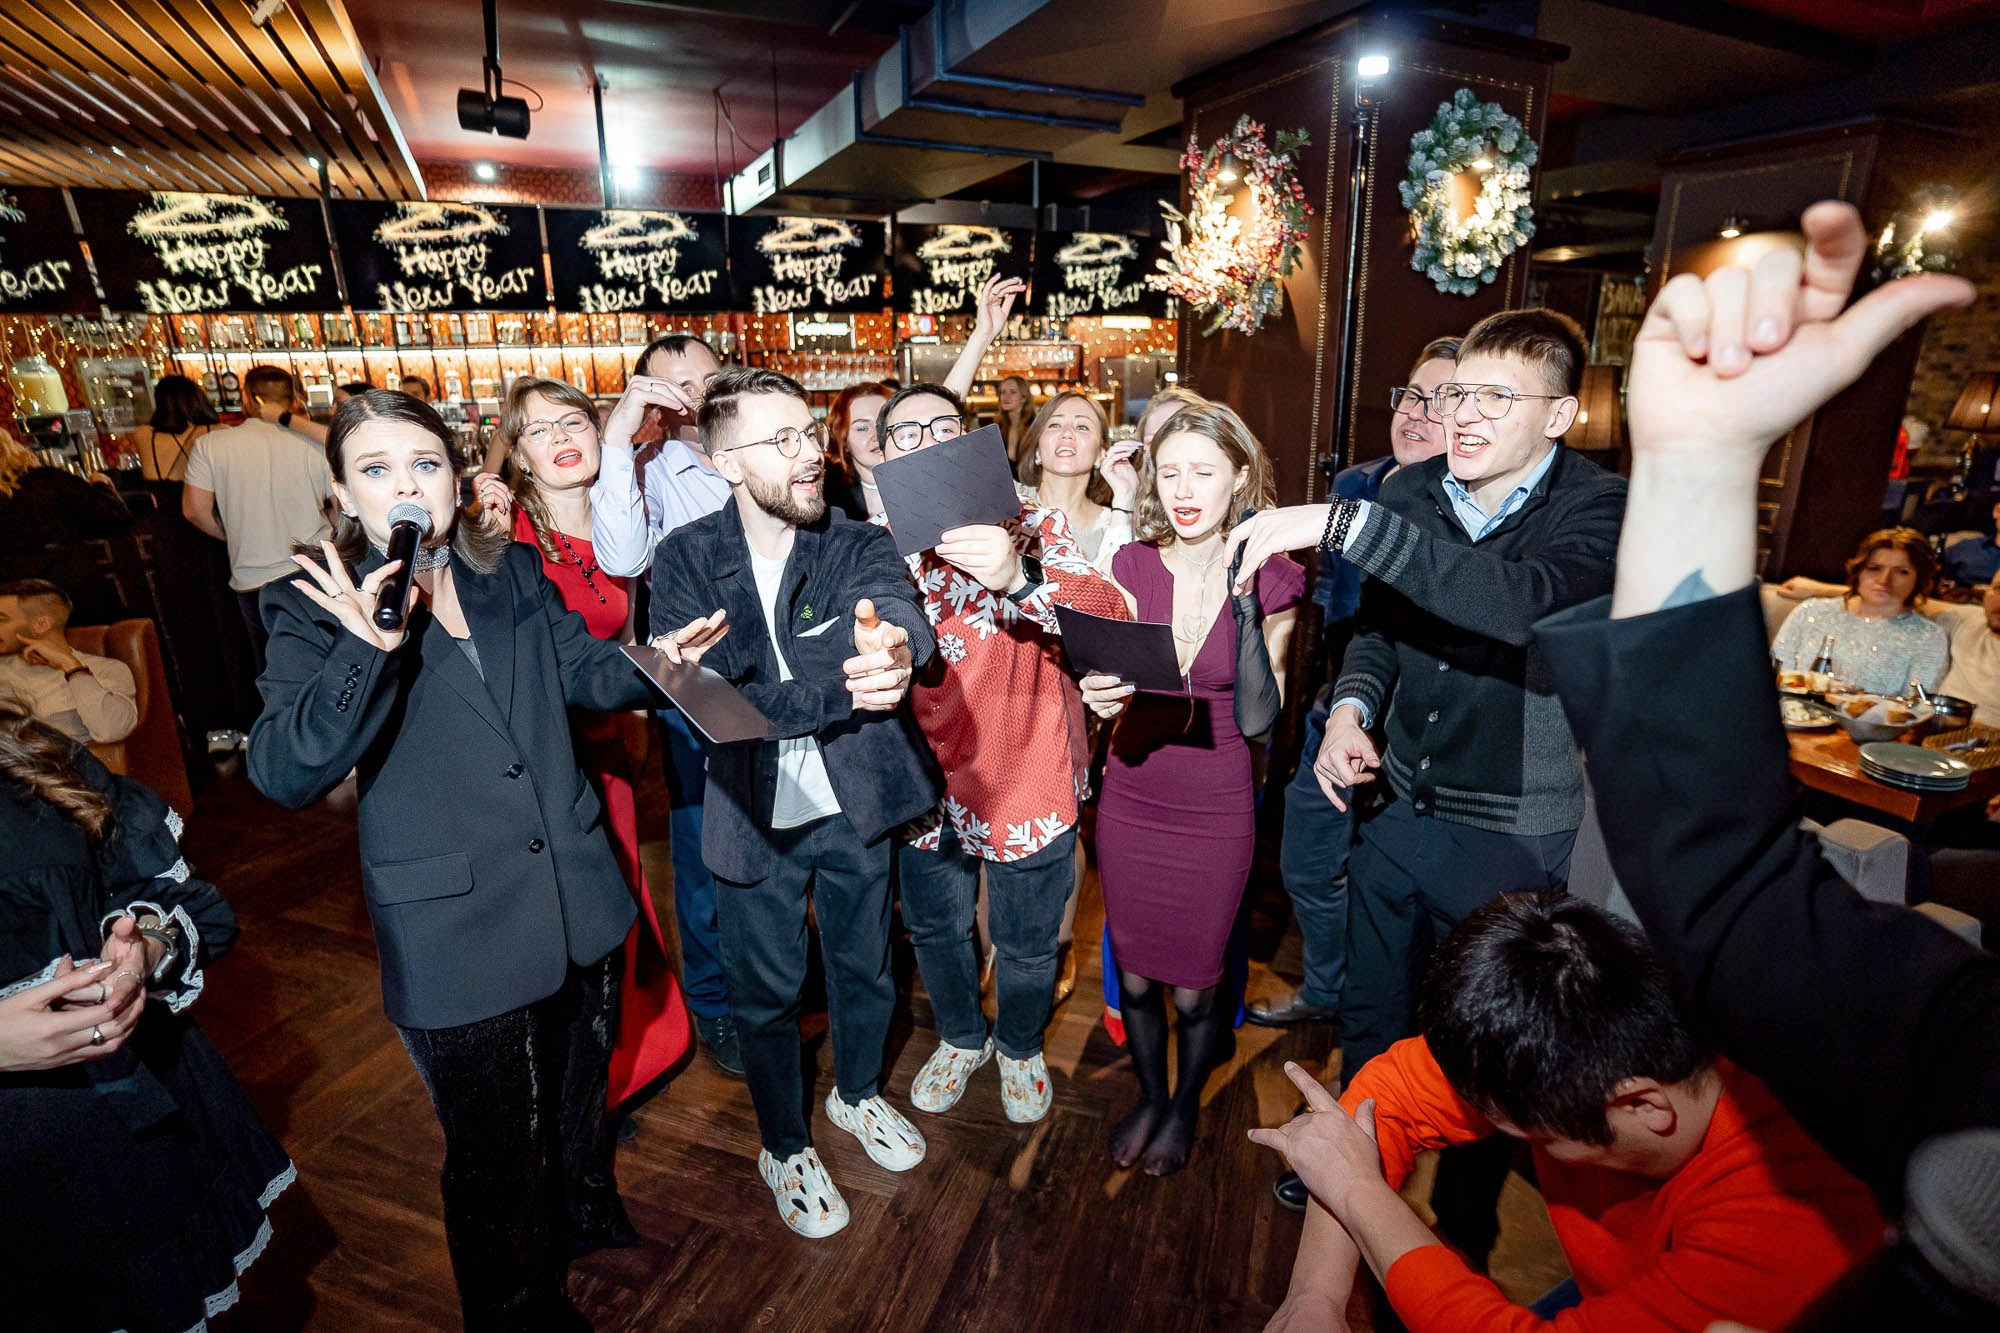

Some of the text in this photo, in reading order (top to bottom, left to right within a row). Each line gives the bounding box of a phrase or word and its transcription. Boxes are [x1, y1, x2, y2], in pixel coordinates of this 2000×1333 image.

[156, 237, 270, 278] Happy
[396, 242, 491, 280] Happy
[597, 247, 681, 282] Happy
[770, 253, 845, 285] Happy
[928, 258, 996, 287] Happy
[0, 259, 71, 299] ear
[137, 264, 322, 314] New Year
[377, 267, 534, 313] New Year
[579, 269, 718, 314] New Year
[753, 274, 877, 313] New Year
[1064, 264, 1123, 292] Happy
[911, 288, 966, 314] New
[1047, 292, 1096, 319] New
[1098, 281, 1146, 310] Year
